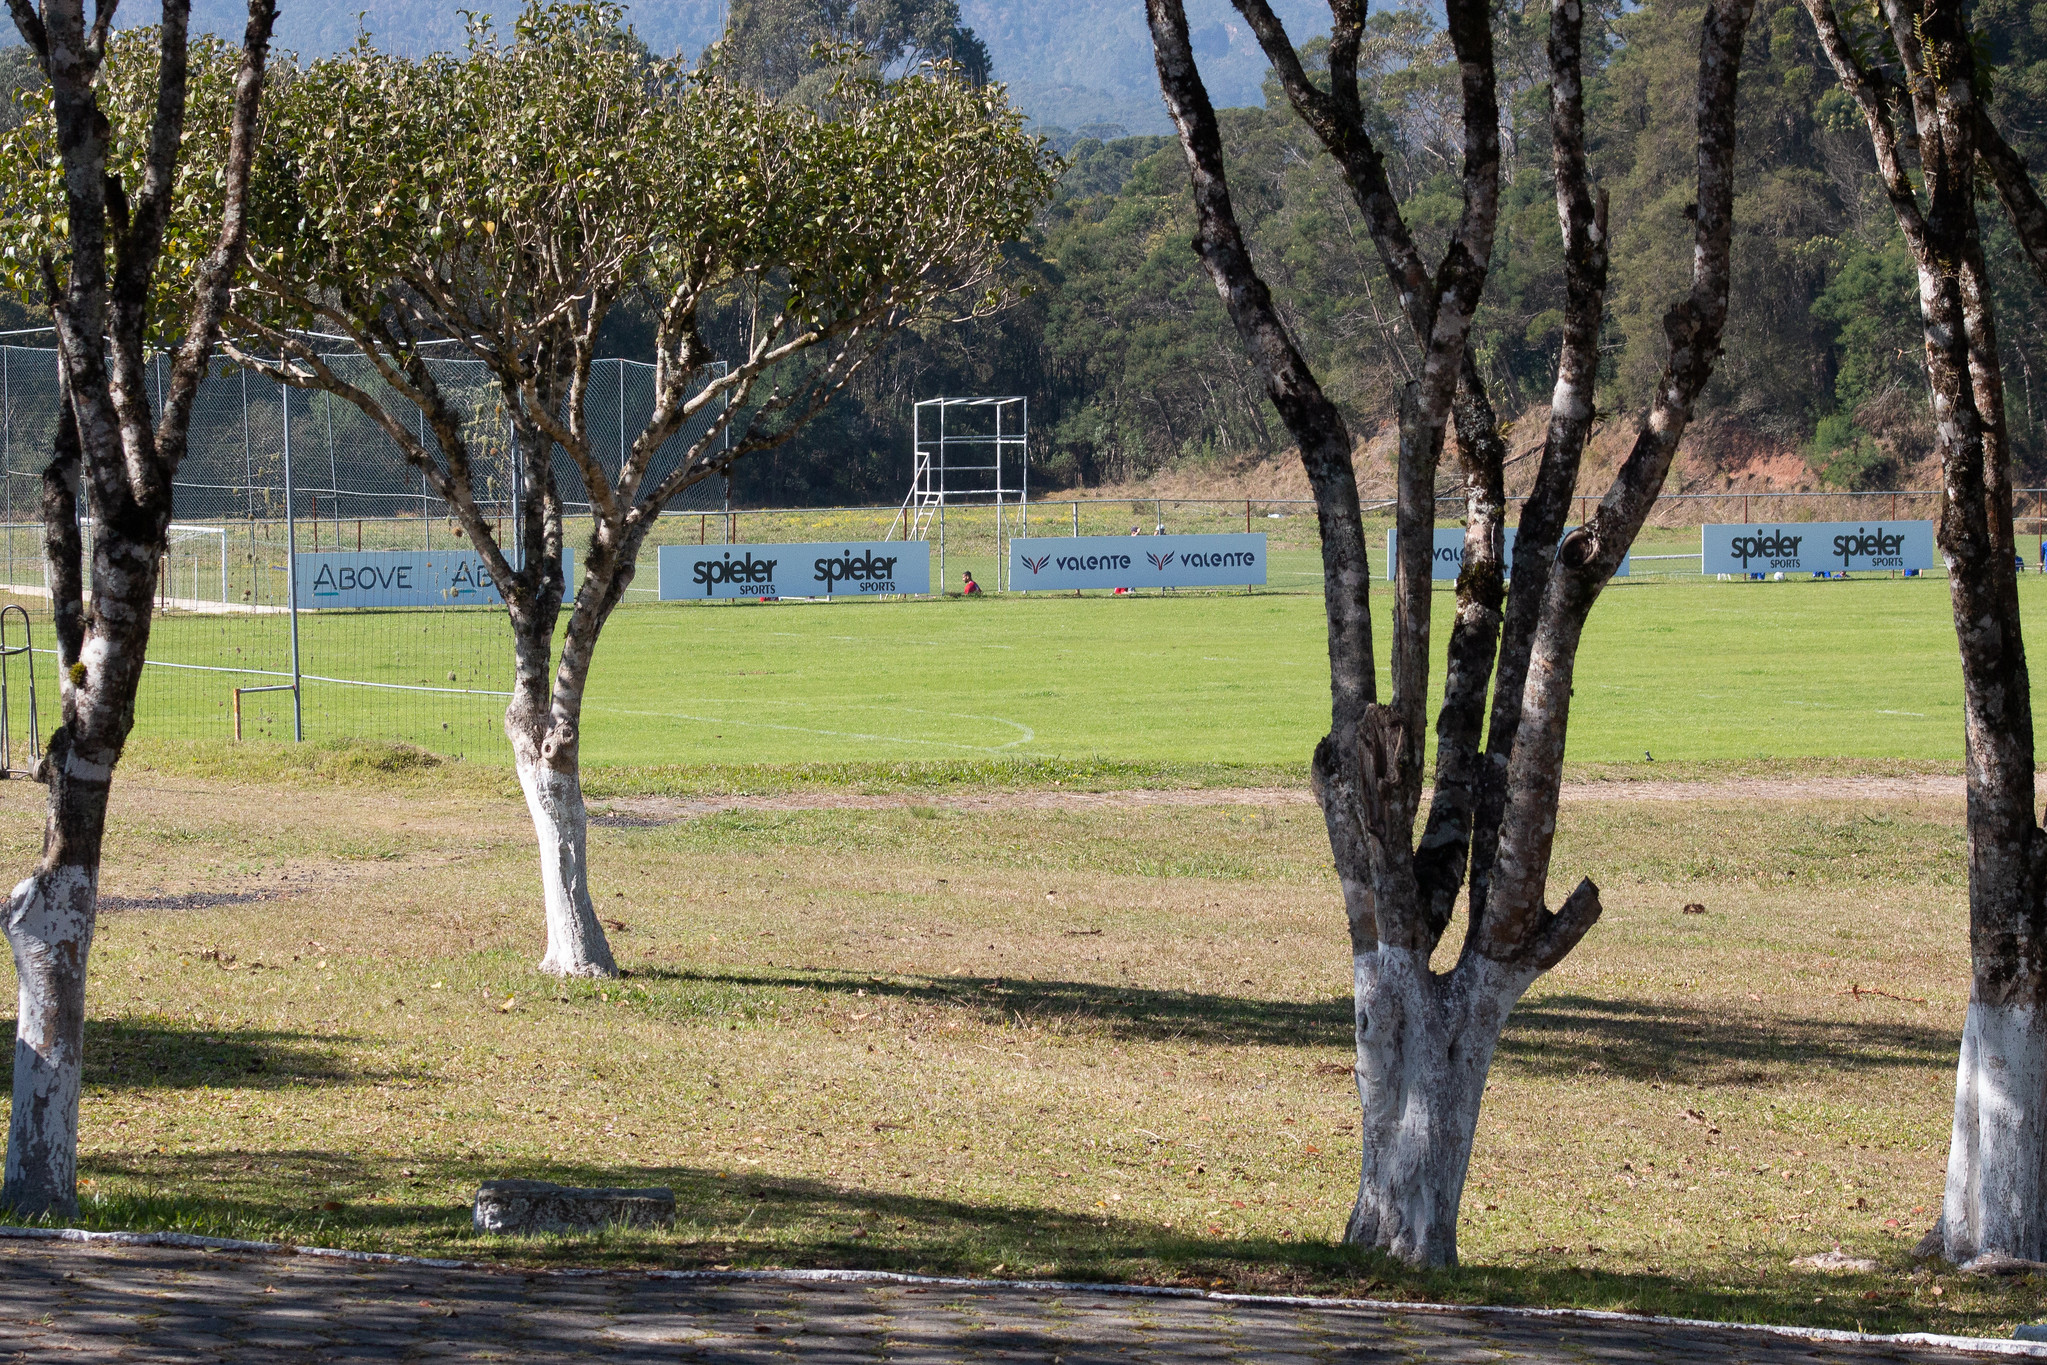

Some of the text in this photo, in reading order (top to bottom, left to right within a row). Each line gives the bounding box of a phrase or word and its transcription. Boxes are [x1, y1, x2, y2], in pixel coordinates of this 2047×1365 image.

[1731, 529, 1803, 569] spieler
[1833, 527, 1905, 567] spieler
[692, 552, 778, 596] spieler
[814, 549, 898, 593] spieler
[1770, 558, 1801, 569] SPORTS
[1872, 557, 1904, 567] SPORTS
[313, 563, 413, 591] ABOVE
[739, 584, 776, 596] SPORTS
[859, 581, 896, 592] SPORTS
